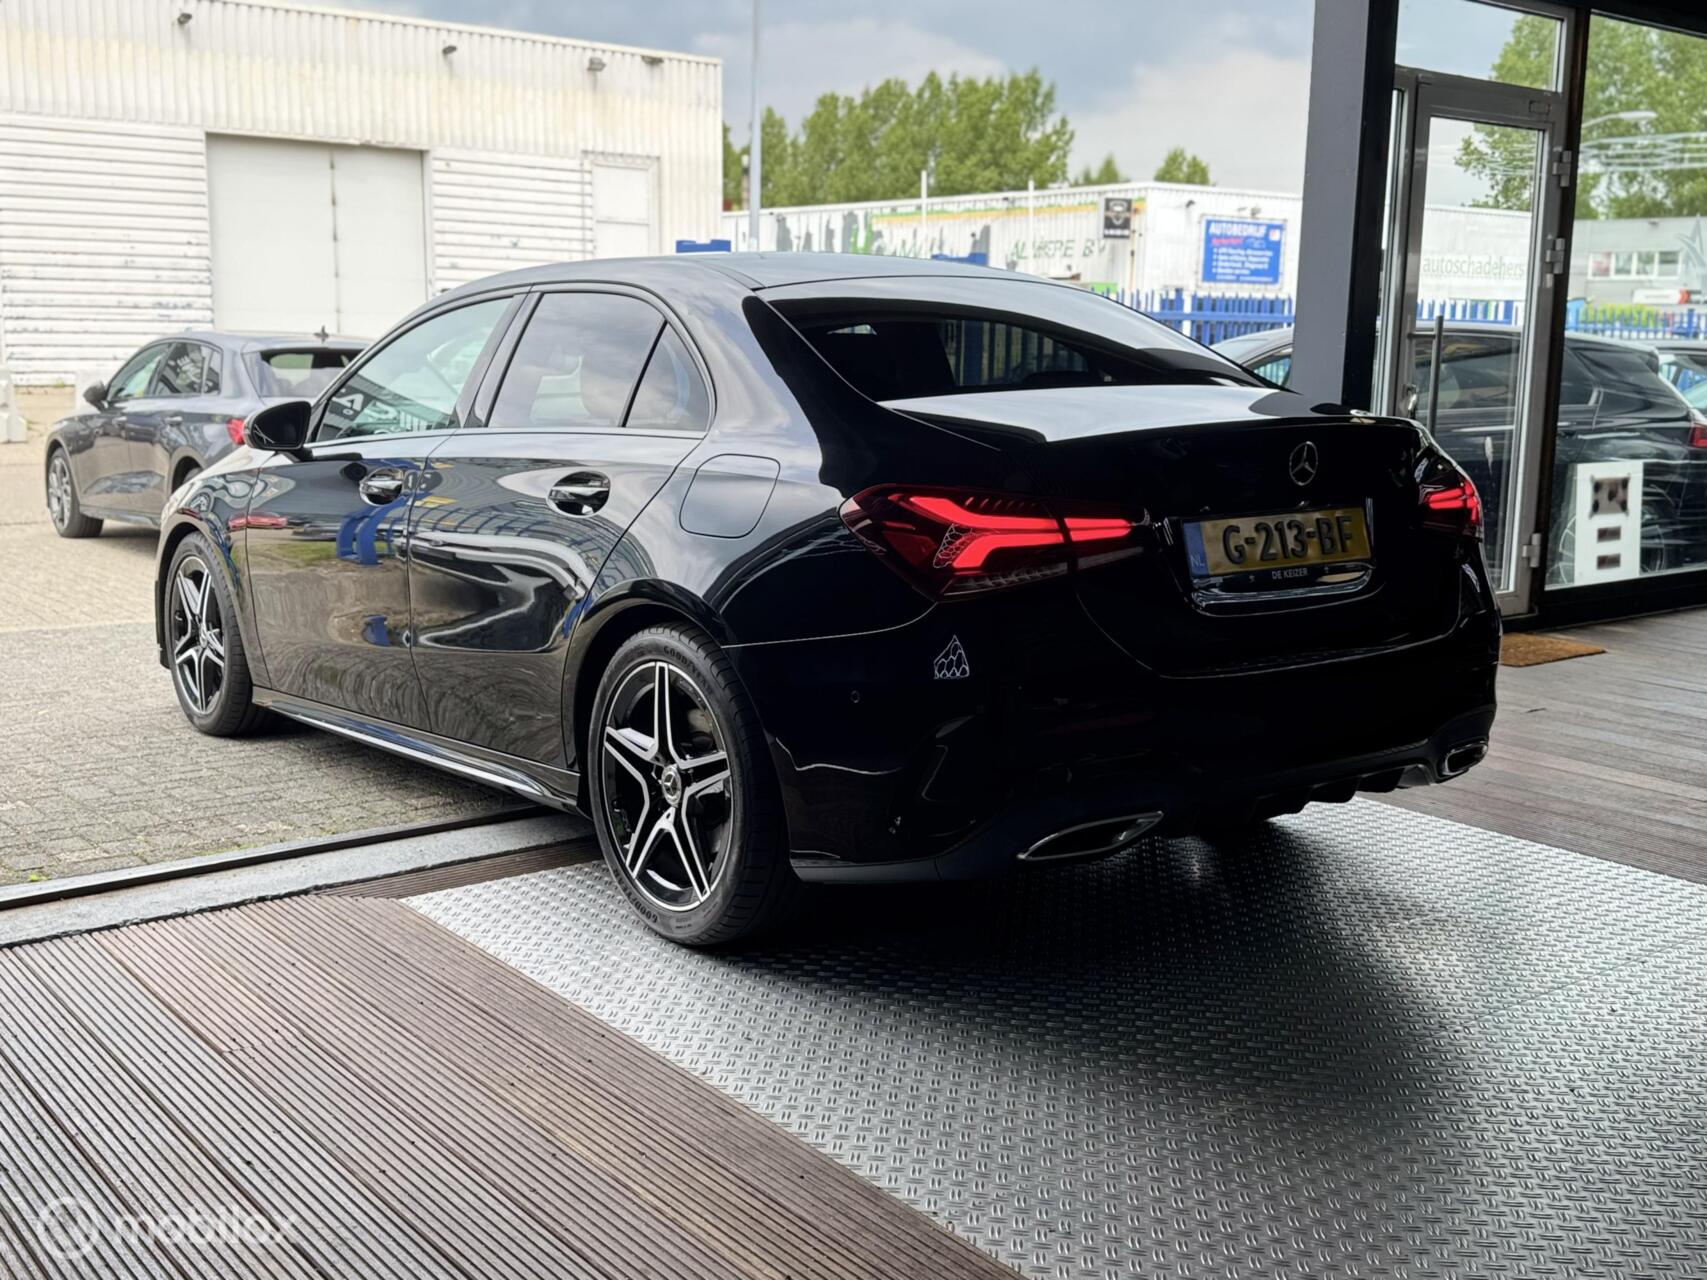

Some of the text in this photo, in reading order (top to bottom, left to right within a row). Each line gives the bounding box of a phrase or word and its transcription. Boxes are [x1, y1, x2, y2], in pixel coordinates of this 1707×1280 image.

[1222, 515, 1353, 564] G-213-BF
[1190, 554, 1205, 567] NL
[1271, 567, 1309, 580] DE KEIZER
